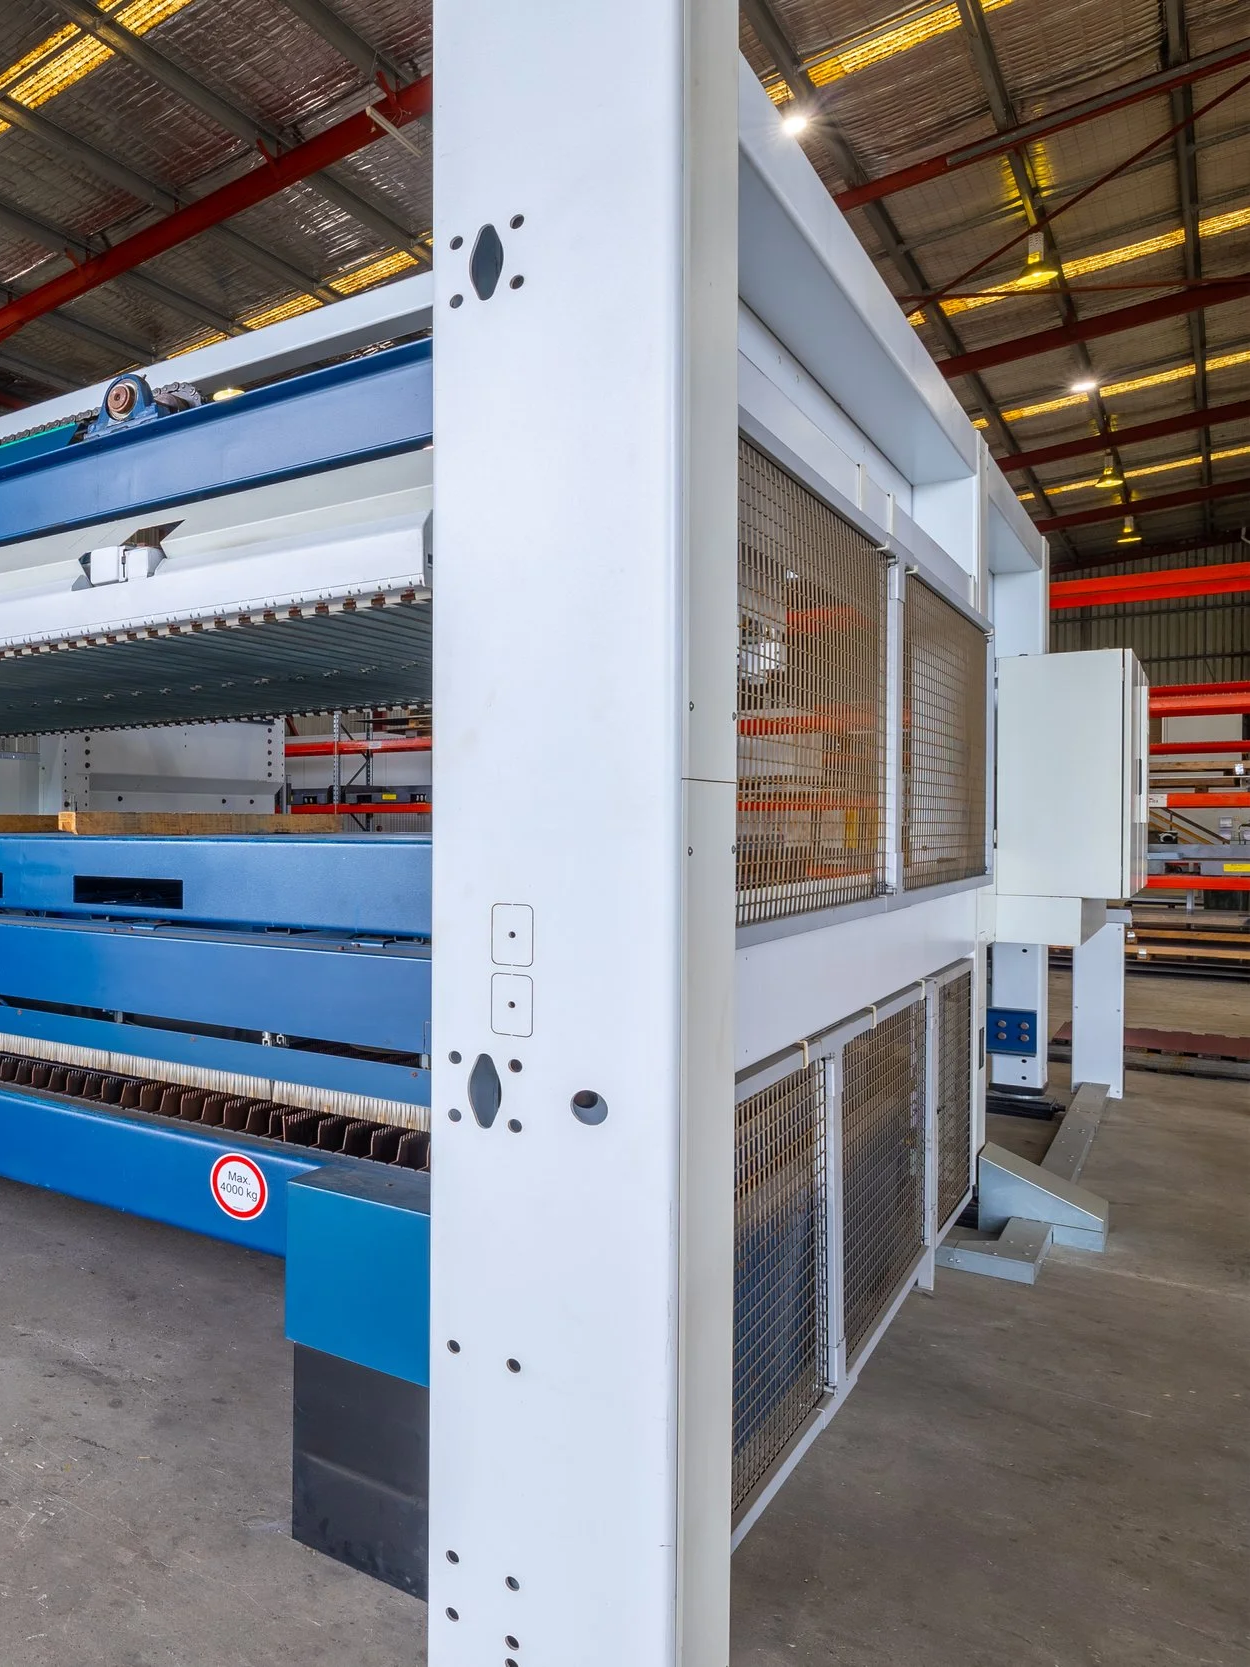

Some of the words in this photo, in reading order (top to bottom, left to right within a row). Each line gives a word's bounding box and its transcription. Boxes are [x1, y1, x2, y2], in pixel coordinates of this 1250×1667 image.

[228, 1171, 251, 1186] Max.
[220, 1182, 244, 1197] 4000
[246, 1188, 258, 1203] kg
